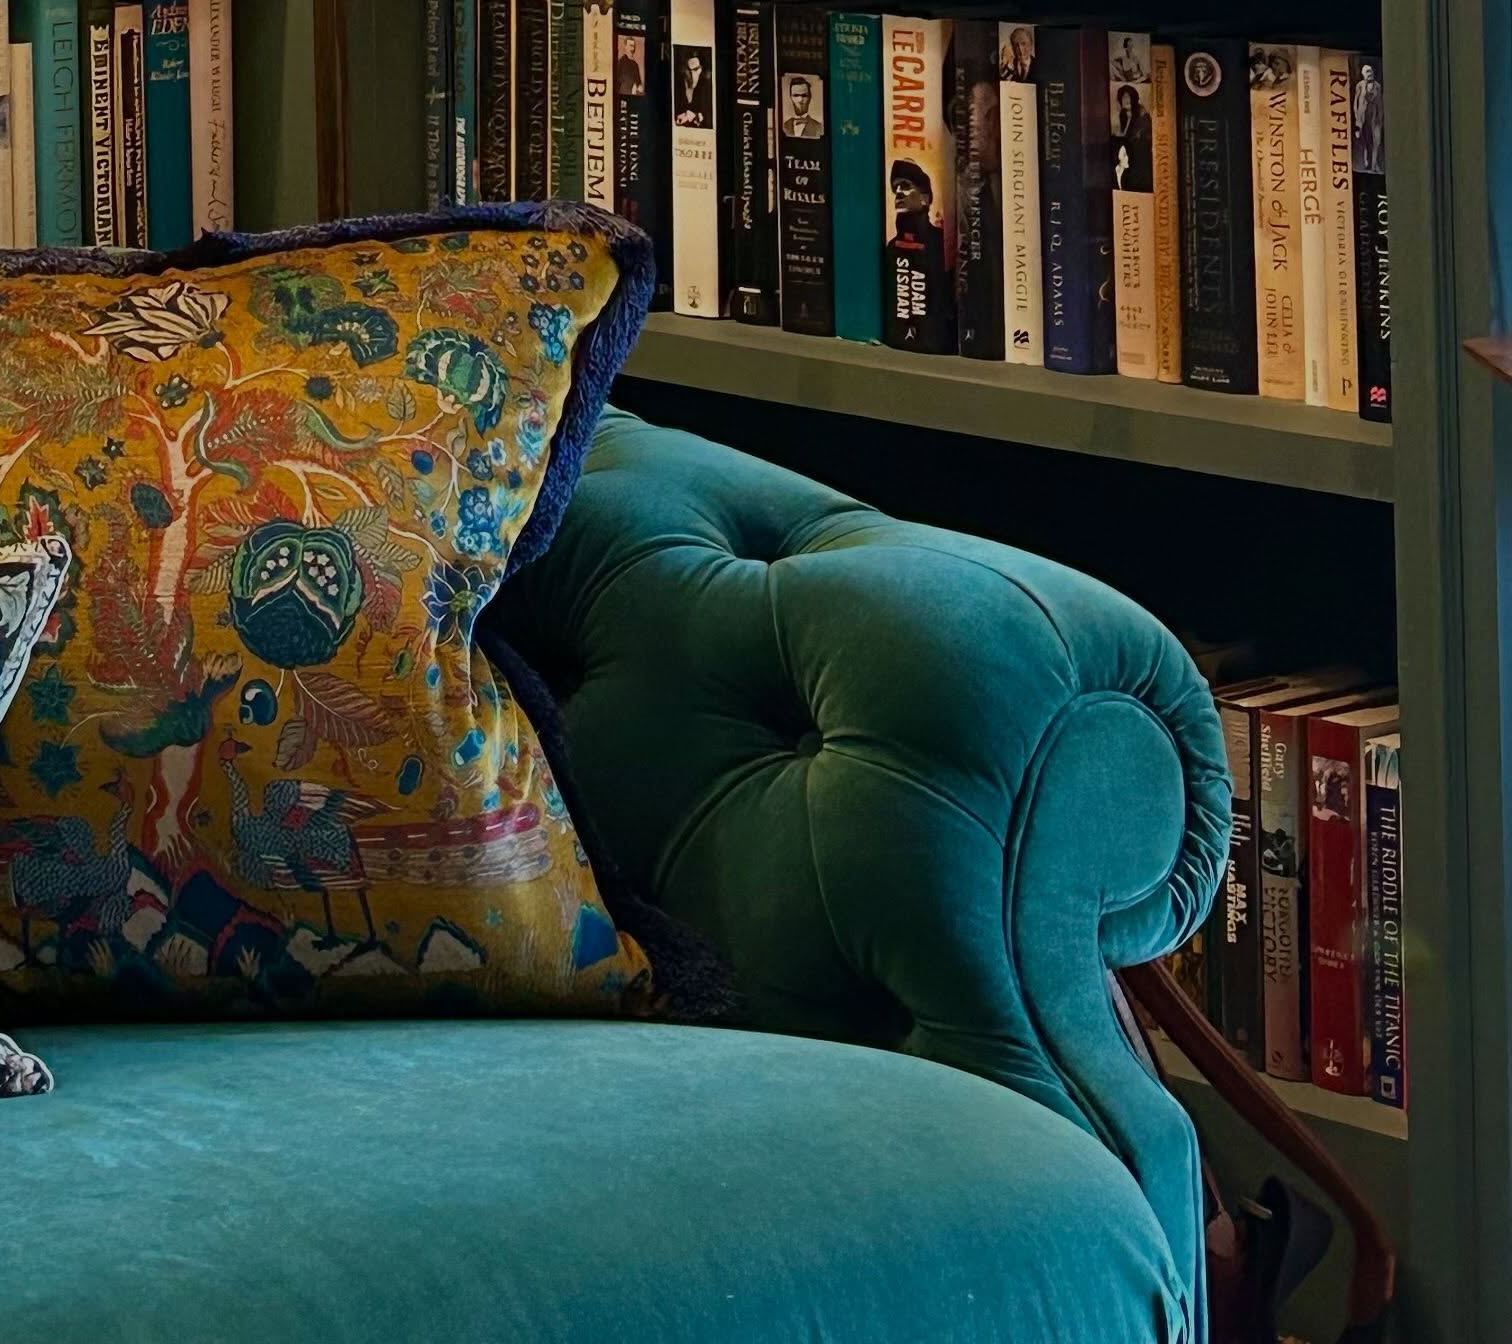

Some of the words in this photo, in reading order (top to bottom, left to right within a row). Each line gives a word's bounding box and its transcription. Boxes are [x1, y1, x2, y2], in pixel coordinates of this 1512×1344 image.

[52, 20, 74, 114] LEIGH
[93, 37, 110, 132] EMINENT
[586, 77, 608, 201] BETJEM
[1010, 95, 1026, 144] JOHN
[1267, 91, 1287, 194] WINSTON
[1330, 68, 1349, 192] RAFFLES
[1012, 149, 1027, 237] SERGEANT
[1299, 147, 1325, 226] HERGÉ
[1376, 192, 1390, 241] ROY
[1015, 244, 1028, 314] MAGGIE
[1269, 222, 1288, 271] JACK
[895, 256, 910, 320] SISMAN
[909, 270, 926, 317] ADAM
[1375, 247, 1392, 341] JENKINS
[1271, 742, 1288, 779] Gary
[1379, 806, 1397, 841] THE
[1226, 859, 1237, 944] HASTINGS
[1235, 883, 1247, 924] MAX
[1380, 848, 1398, 913] RIDDLE
[1381, 921, 1398, 947] OF
[1382, 951, 1400, 986] THE
[1383, 994, 1401, 1070] TITANIC
